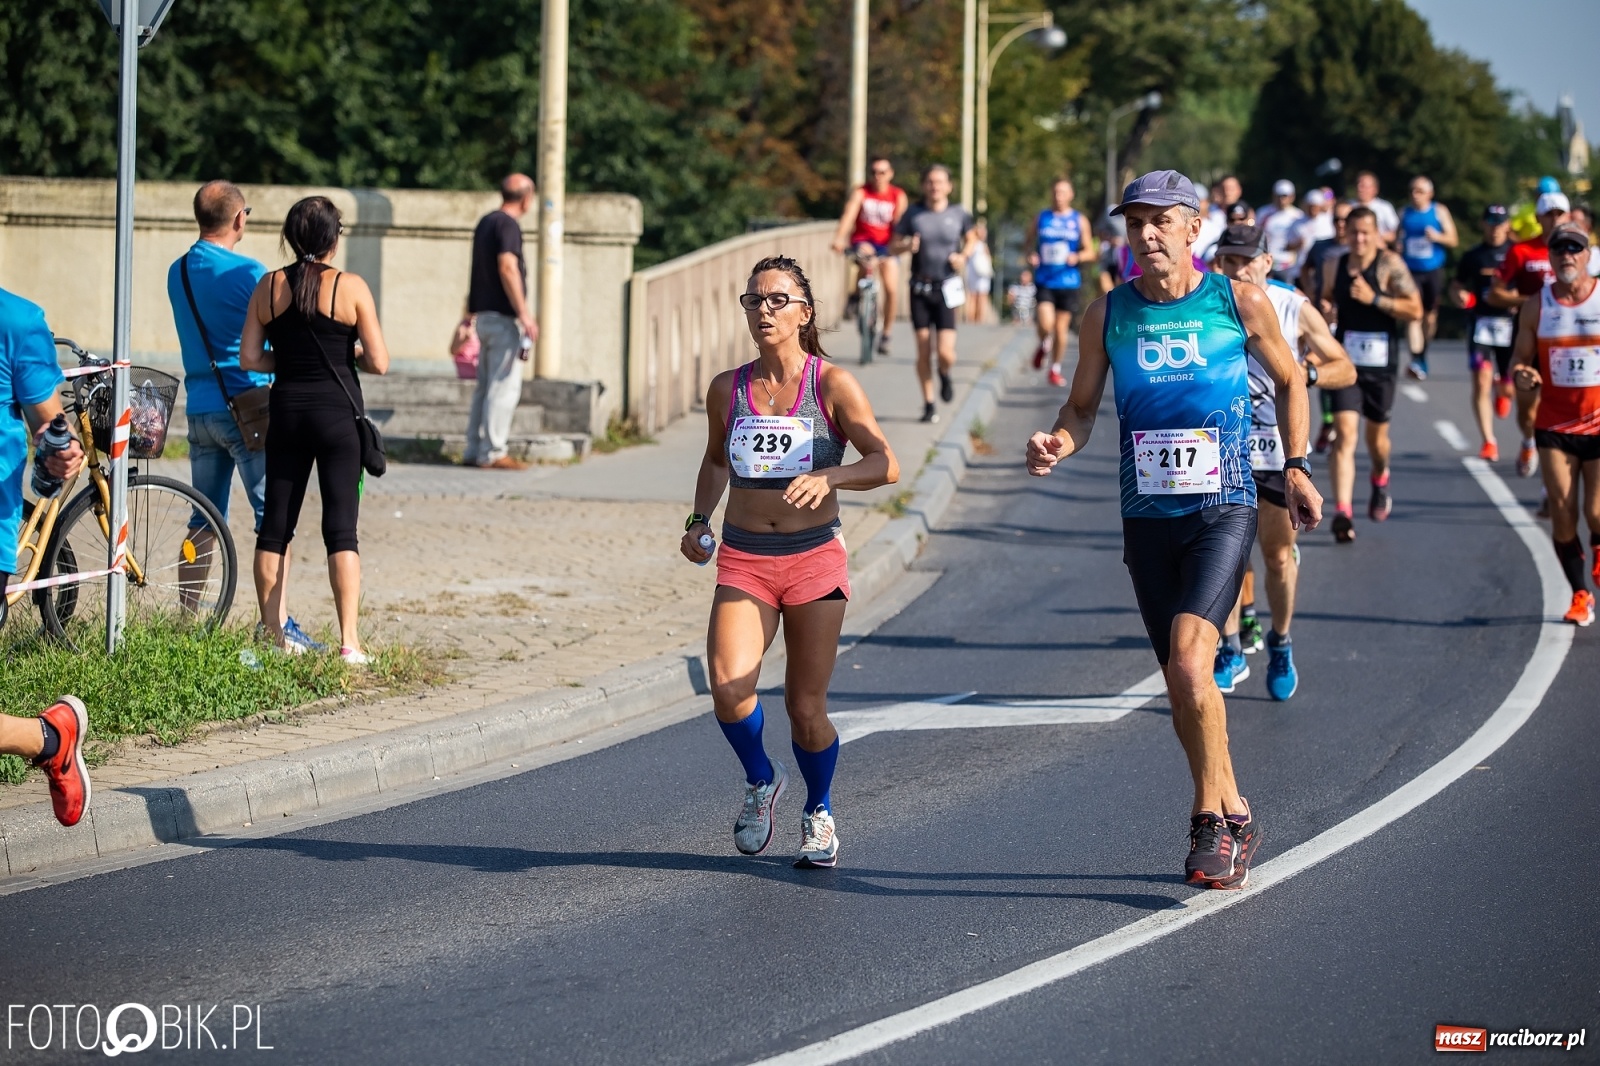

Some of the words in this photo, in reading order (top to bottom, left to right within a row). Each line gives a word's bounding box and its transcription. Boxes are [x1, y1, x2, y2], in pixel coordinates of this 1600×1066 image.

[1137, 333, 1207, 371] bbl
[1567, 358, 1585, 371] 32
[1149, 373, 1195, 384] RACIBÓRZ
[753, 432, 792, 454] 239
[1249, 438, 1277, 453] 209
[1159, 447, 1197, 468] 217
